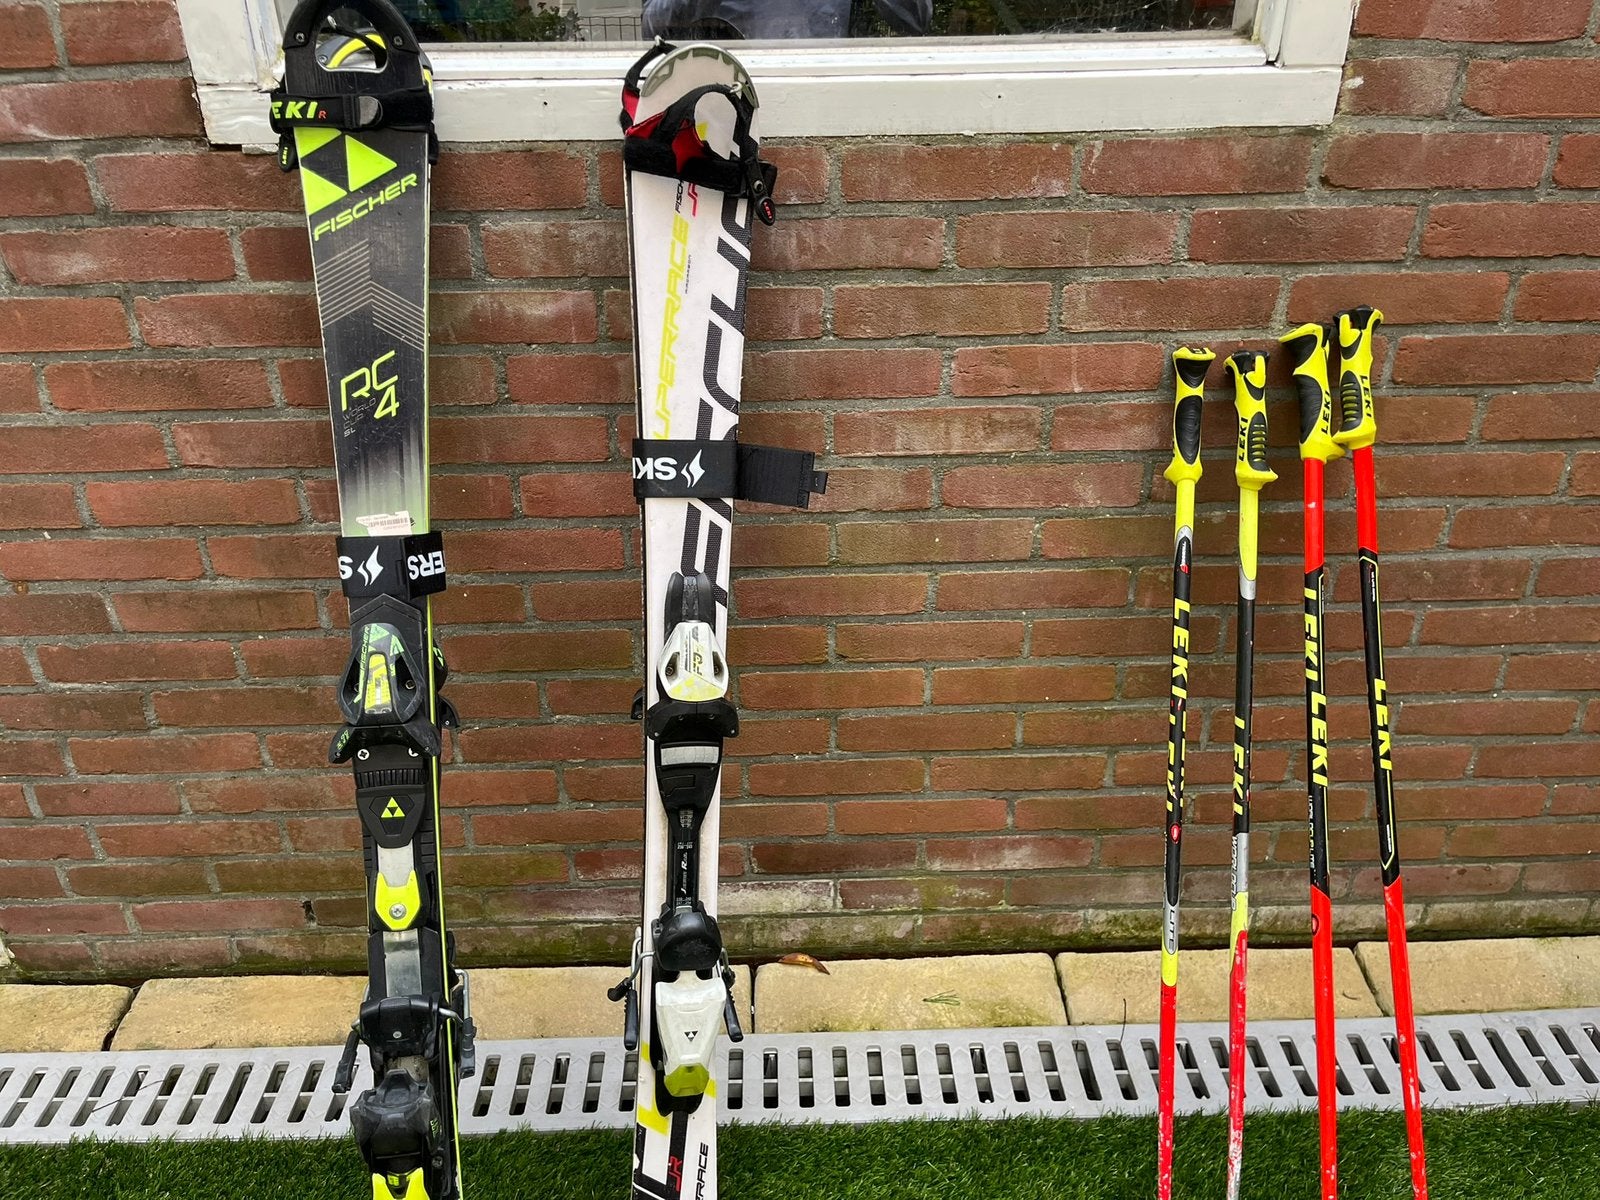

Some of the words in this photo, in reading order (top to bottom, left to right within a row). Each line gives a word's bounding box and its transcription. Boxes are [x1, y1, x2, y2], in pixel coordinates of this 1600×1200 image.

[313, 173, 418, 241] FISCHER
[653, 213, 690, 440] UPERRACE
[1320, 391, 1332, 435] LEKI
[1360, 375, 1372, 418] LEKI
[1239, 417, 1249, 462] LEKI
[360, 626, 370, 670] FISCHER
[1172, 597, 1191, 700] LEKI
[1311, 690, 1329, 788] LEKI
[1373, 678, 1393, 771] LEKI
